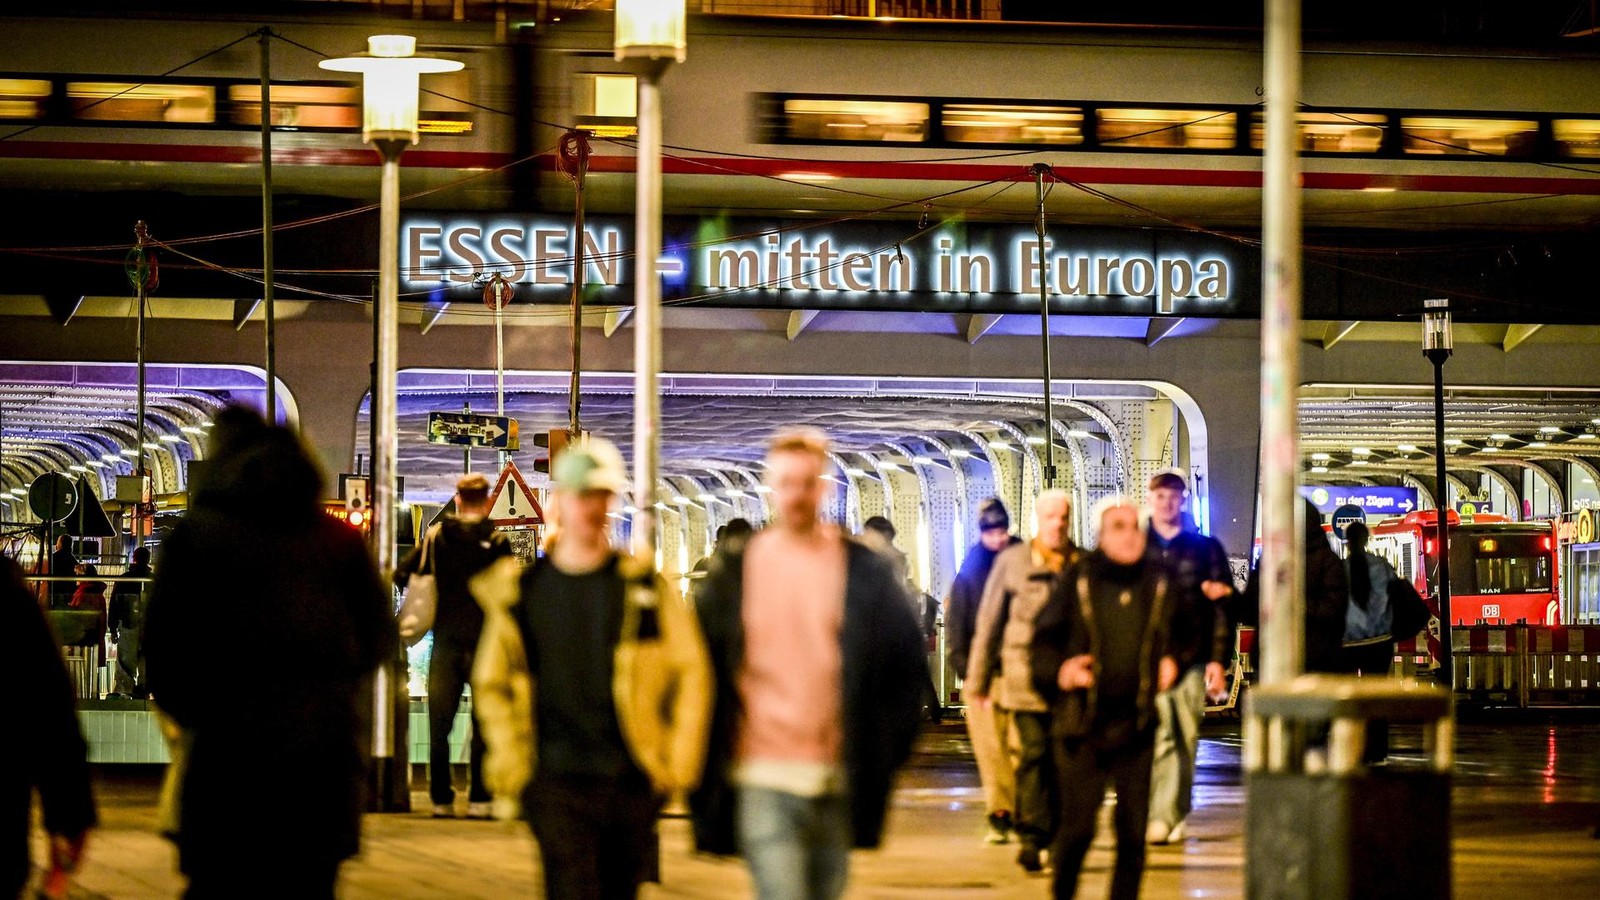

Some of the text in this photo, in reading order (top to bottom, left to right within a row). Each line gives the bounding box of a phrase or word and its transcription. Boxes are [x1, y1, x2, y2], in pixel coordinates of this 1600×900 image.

[408, 226, 618, 285] ESSEN
[709, 235, 912, 291] mitten
[939, 239, 992, 293] in
[1020, 240, 1228, 313] Europa
[1335, 495, 1394, 508] zu den Zügen
[1480, 504, 1489, 514] 6
[1484, 605, 1498, 616] DB
